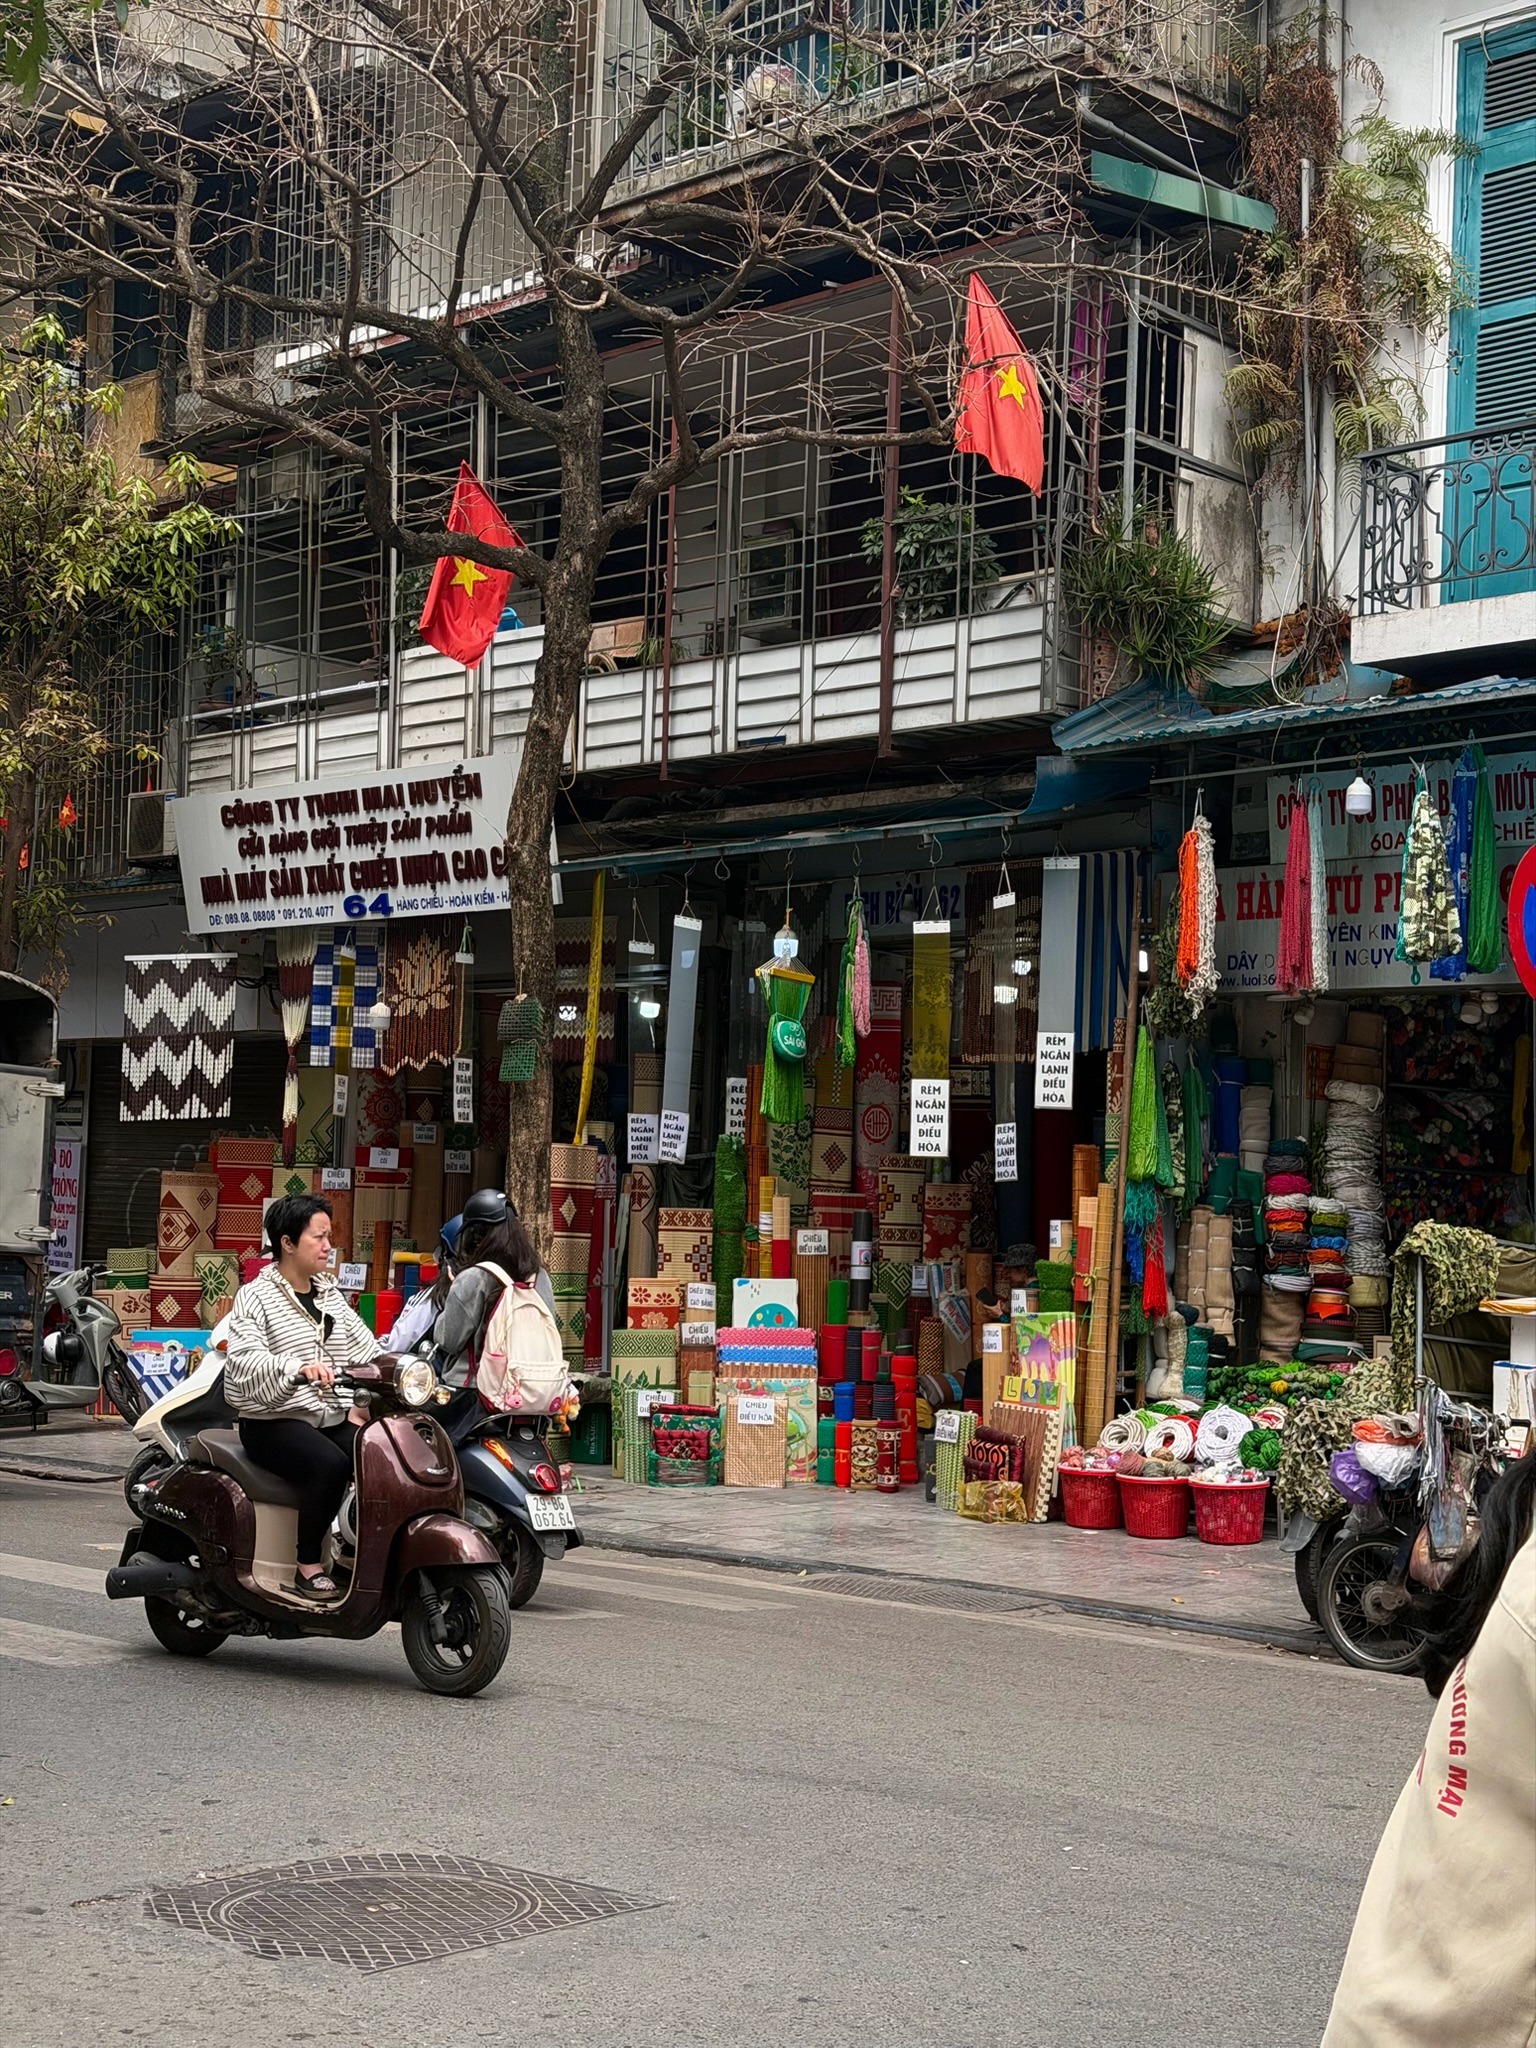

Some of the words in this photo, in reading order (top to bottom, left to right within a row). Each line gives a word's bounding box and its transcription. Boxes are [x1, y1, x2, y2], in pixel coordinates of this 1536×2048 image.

[221, 798, 274, 828] CÔNG
[275, 797, 300, 824] TY
[303, 789, 360, 820] TNHH
[361, 783, 406, 811] MAI
[238, 827, 265, 858] CỬA
[269, 827, 309, 855] HÀNG
[391, 810, 422, 842] SẢN
[425, 801, 473, 839] PHẨM
[1370, 831, 1407, 852] 60A
[200, 868, 235, 904] NHÀ
[235, 864, 267, 901] MÁY
[269, 857, 304, 899] SẢN
[304, 853, 346, 896] XUẤT
[1326, 865, 1363, 914] TÚ
[209, 912, 223, 926] DĐ:
[343, 893, 395, 918] 64
[397, 896, 419, 912] HÀNG
[449, 892, 473, 908] HOÀN
[474, 887, 495, 905] KIẾM
[940, 885, 960, 920] 62
[1227, 950, 1258, 970] DÂY
[1045, 1035, 1066, 1046] RÈM
[1041, 1064, 1068, 1076] LẠNH
[920, 1084, 942, 1095] RÈM
[1042, 1091, 1065, 1103] HÒA
[916, 1113, 943, 1125] LẠNH
[918, 1141, 942, 1152] HÒA
[533, 1496, 565, 1512] 29-BG
[534, 1512, 573, 1528] 062.64
[1437, 1764, 1467, 1818] MẠI
